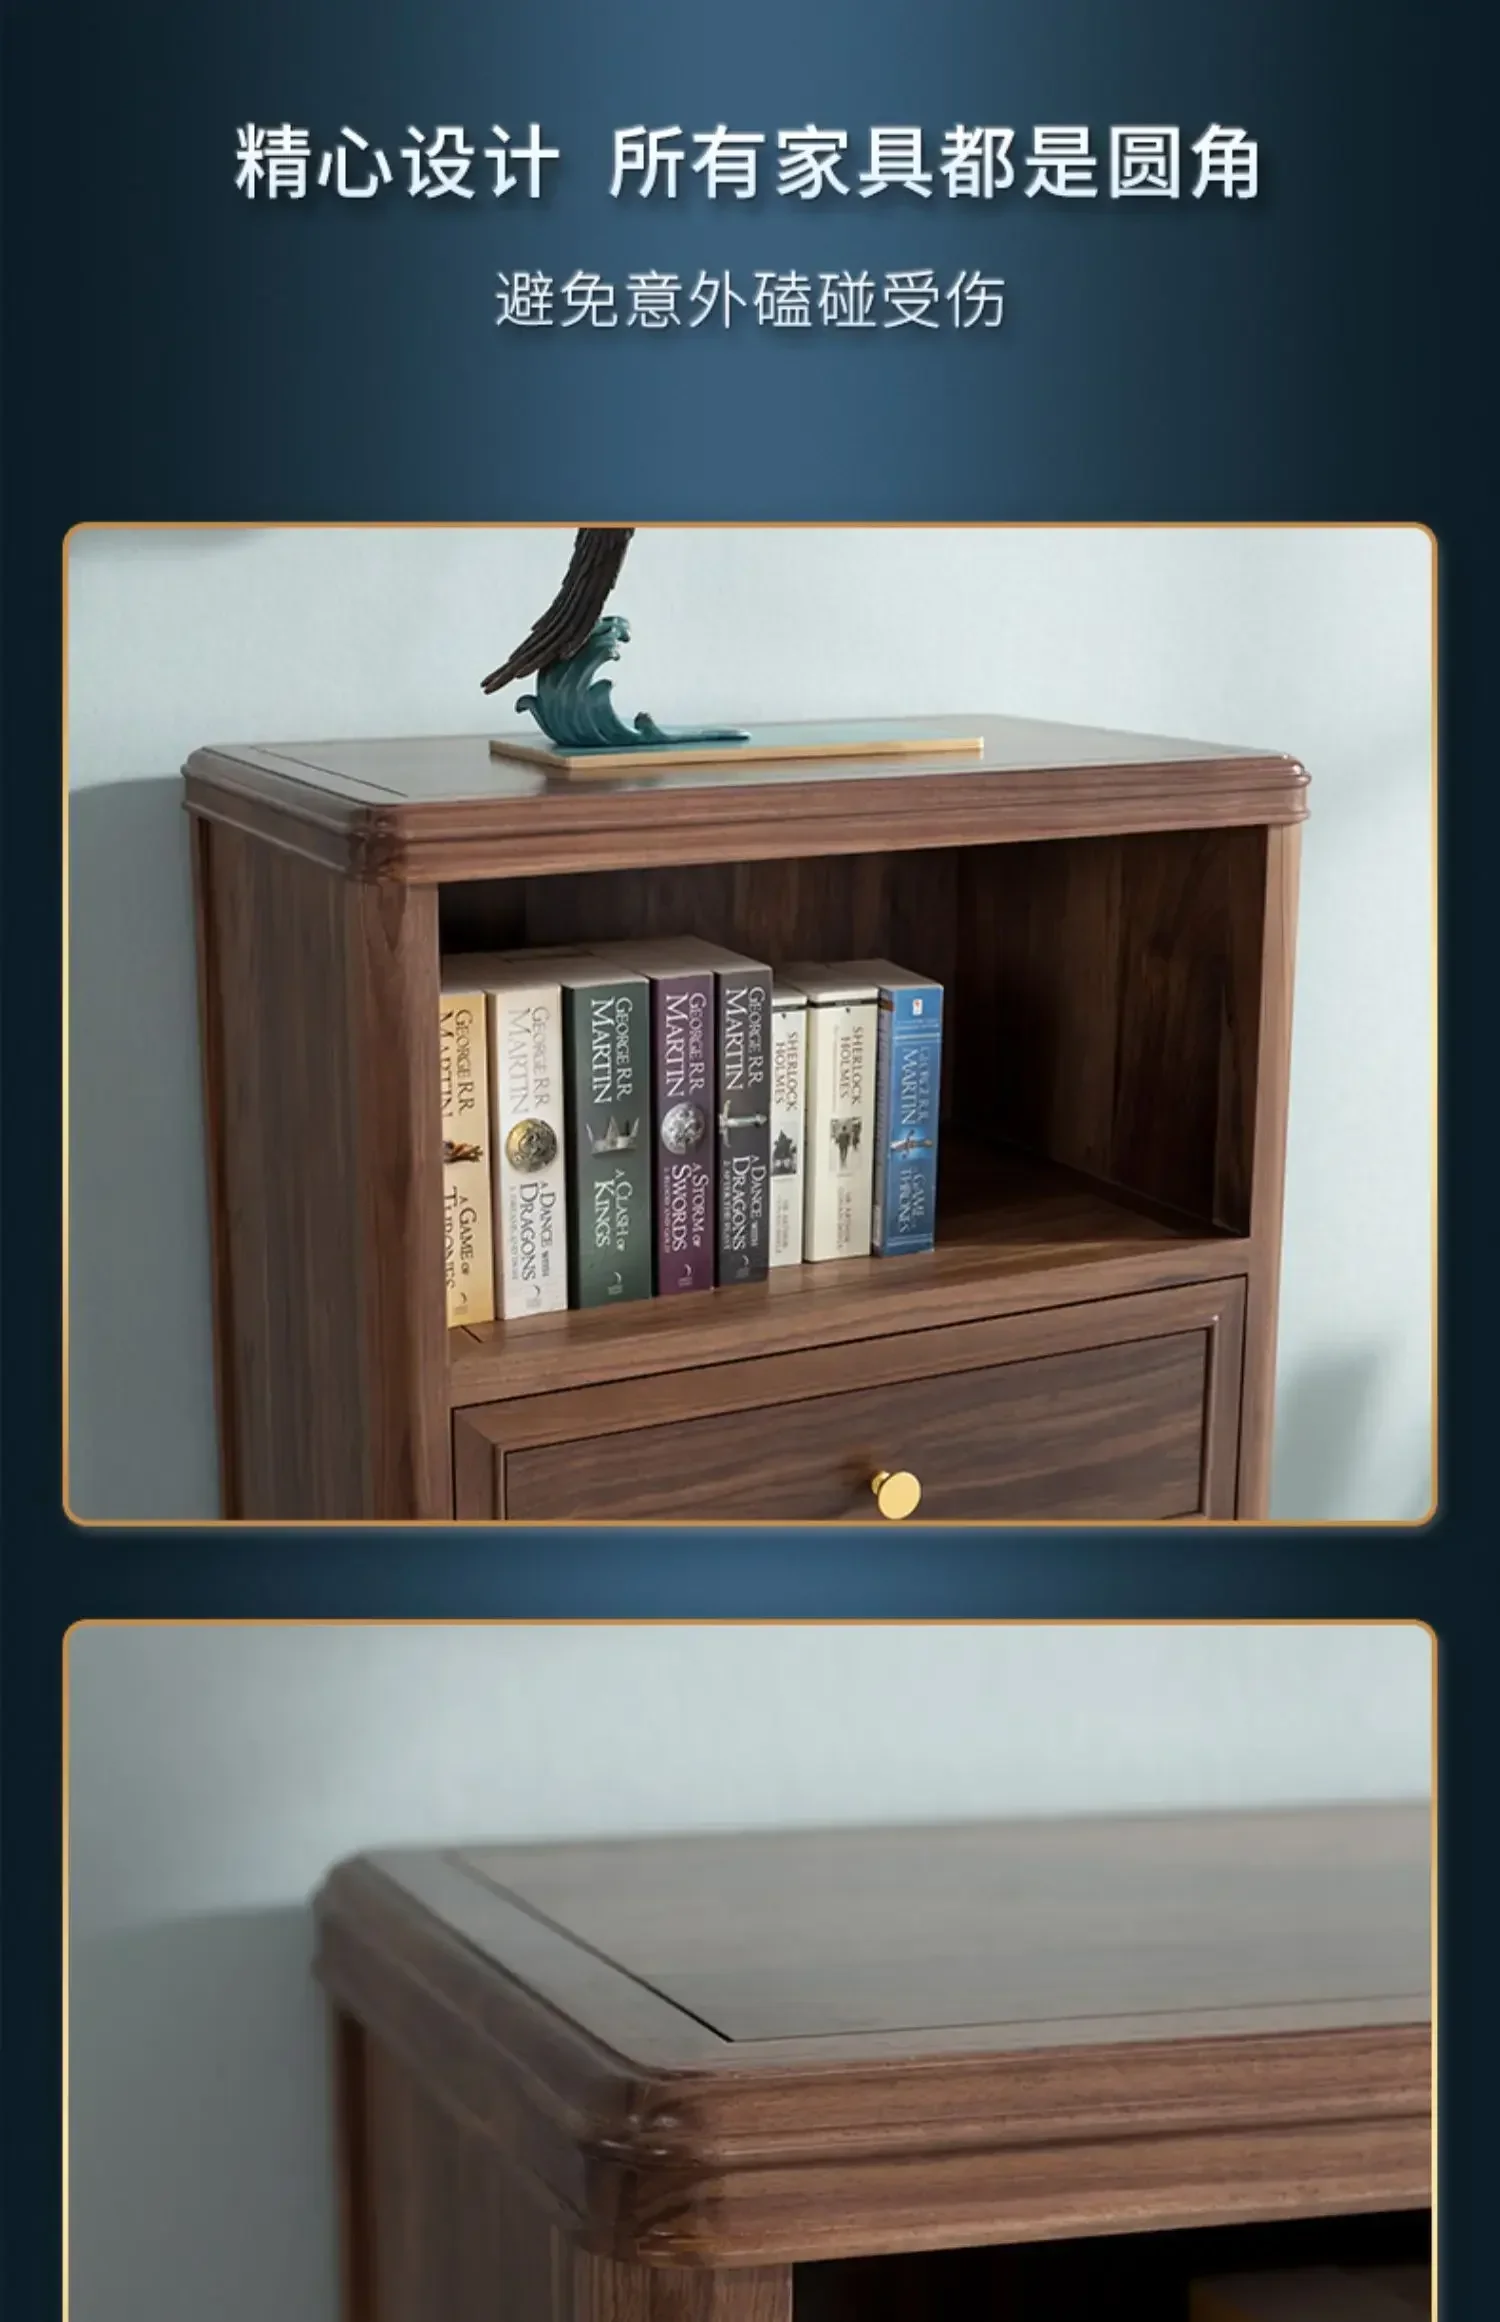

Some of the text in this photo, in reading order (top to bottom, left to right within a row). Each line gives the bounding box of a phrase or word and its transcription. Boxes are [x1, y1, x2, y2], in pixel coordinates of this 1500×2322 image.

[455, 1009, 473, 1079] GEORGE
[531, 1006, 550, 1075] GEORGE
[591, 996, 615, 1104] MARTIN
[615, 997, 632, 1065] GEORGE
[666, 992, 689, 1097] MARTIN
[689, 992, 707, 1062] GEORGE
[725, 986, 748, 1091] MARTIN
[748, 986, 765, 1053] GEORGE
[508, 1008, 531, 1115] MARTIN
[775, 1042, 786, 1105] HOLMES
[786, 1031, 798, 1112] SHERLOCK
[840, 1036, 851, 1099] HOLMES
[851, 1025, 863, 1105] SHERLOCK
[901, 1048, 918, 1125] MARTIN
[539, 1180, 549, 1189] A
[750, 1154, 760, 1162] A
[751, 1165, 766, 1218] DANCE
[459, 1195, 477, 1275] A GAME OF
[520, 1182, 538, 1281] DRAGONS
[540, 1191, 556, 1247] DANCE
[594, 1179, 615, 1248] KINGS
[615, 1168, 633, 1252] A CLASH OF
[671, 1164, 692, 1252] SWORDS
[692, 1162, 708, 1248] A STORM OF
[732, 1156, 750, 1251] DRAGONS
